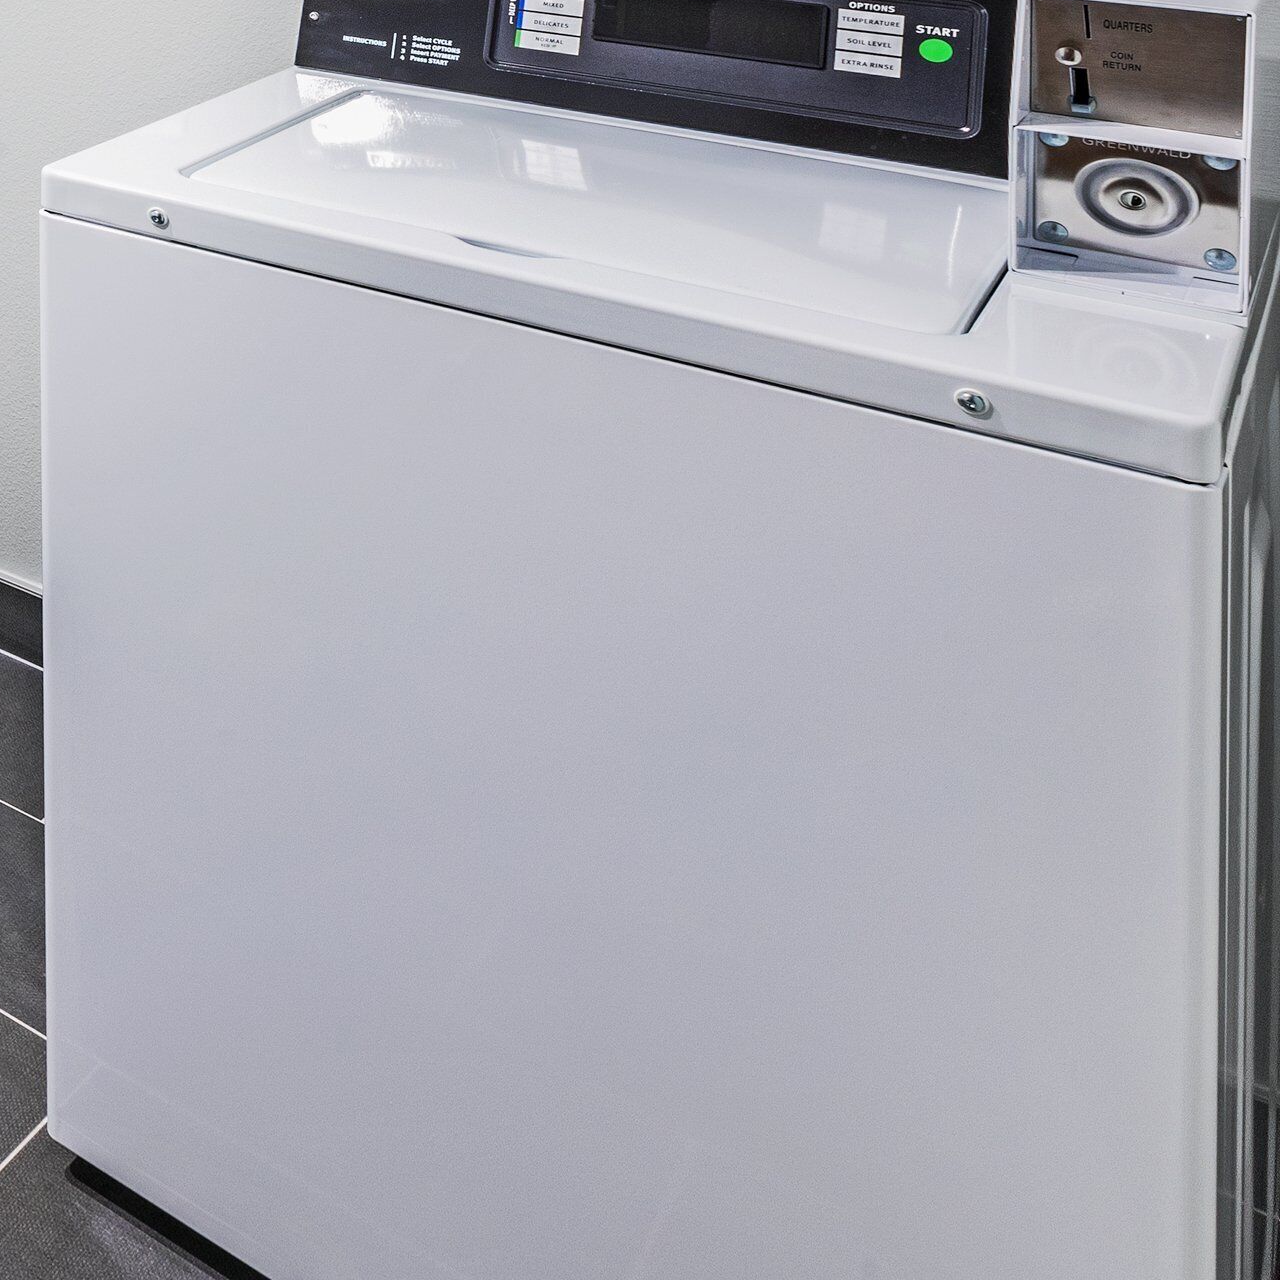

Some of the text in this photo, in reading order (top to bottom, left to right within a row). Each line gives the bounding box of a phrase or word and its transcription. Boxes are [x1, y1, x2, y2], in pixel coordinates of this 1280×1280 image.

[543, 1, 564, 9] MIXED
[848, 1, 896, 13] OPTIONS
[534, 19, 569, 29] DELICATES
[842, 16, 900, 28] TEMPERATURE
[1103, 19, 1154, 34] QUARTERS
[915, 25, 960, 38] START
[342, 35, 388, 47] INSTRUCTIONS
[412, 35, 432, 44] Select
[432, 38, 453, 46] CYCLE
[535, 36, 564, 45] NORMAL
[847, 38, 892, 49] SOIL LEVEL
[410, 48, 429, 57] Insert
[429, 51, 460, 61] PAYMENT
[411, 42, 431, 51] Select
[431, 45, 461, 55] OPTIONS
[409, 55, 428, 64] Press
[427, 58, 449, 67] START
[1110, 51, 1134, 61] COIN
[841, 58, 894, 71] EXTRA RINSE
[1102, 61, 1142, 72] RETURN
